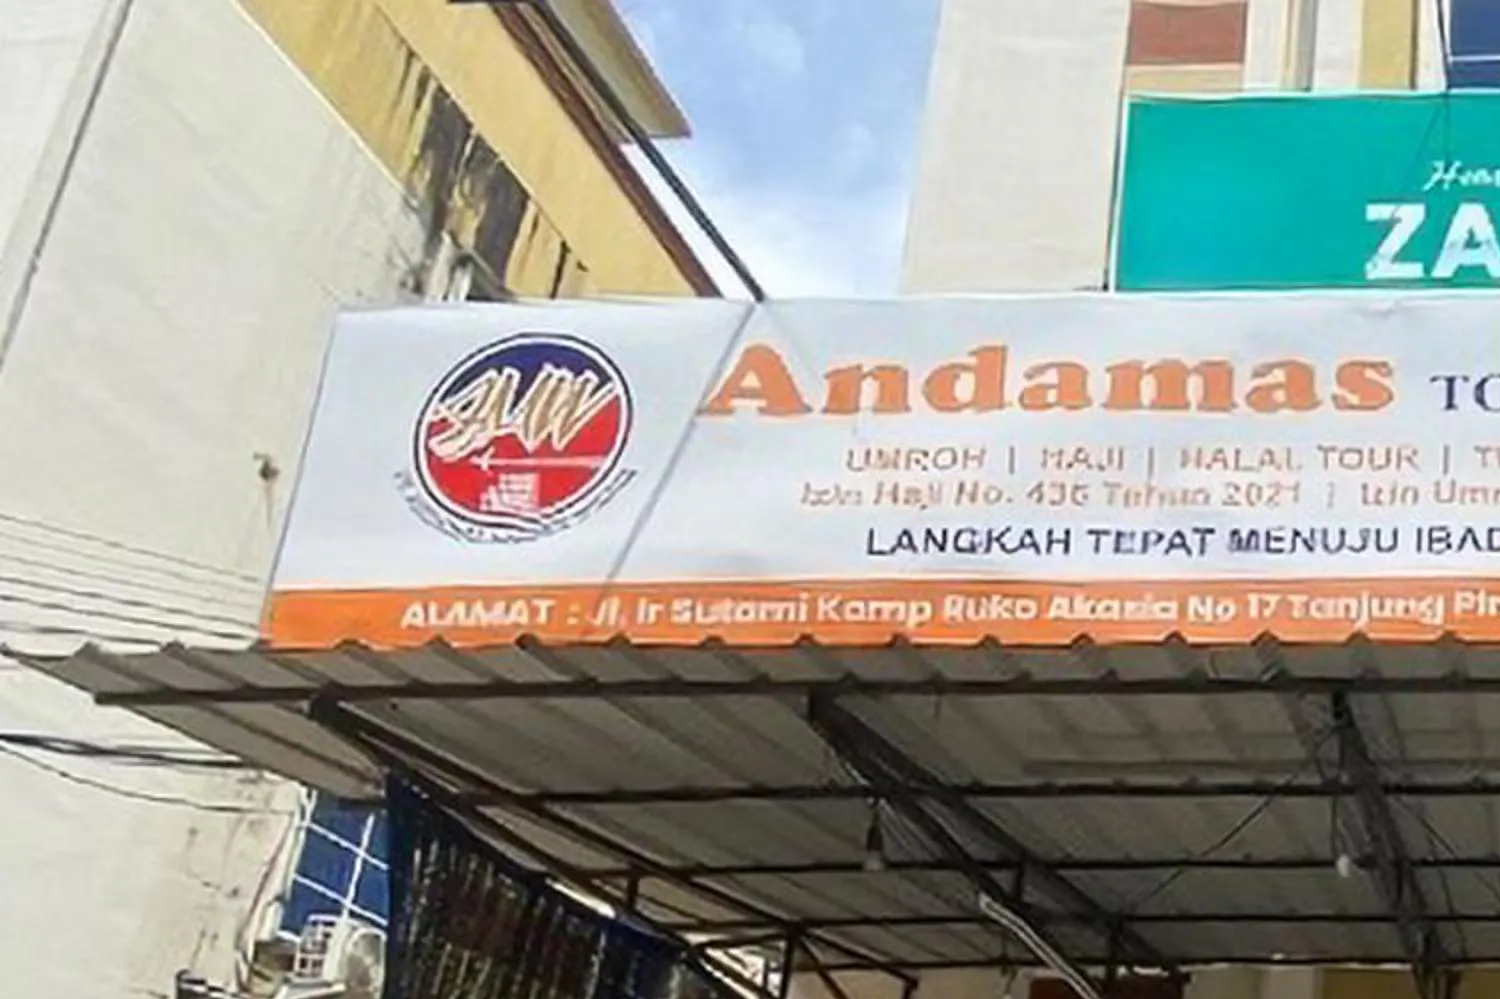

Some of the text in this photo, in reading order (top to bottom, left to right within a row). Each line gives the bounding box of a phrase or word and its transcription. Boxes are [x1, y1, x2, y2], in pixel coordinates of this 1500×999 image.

[697, 344, 1397, 417] Andamas
[846, 446, 986, 472] UMROH
[1180, 446, 1303, 472] HALAL
[1316, 444, 1419, 471] TOUR
[866, 526, 1072, 557] LANGKAH
[1086, 526, 1216, 557] TEPAT
[1227, 525, 1400, 555] MENUJU
[401, 598, 556, 629] ALAMAT
[670, 592, 808, 625] Sutami
[944, 593, 1039, 622] Ruko
[1187, 595, 1238, 625] No
[1247, 591, 1280, 620] 17
[1286, 590, 1445, 629] Tanjung
